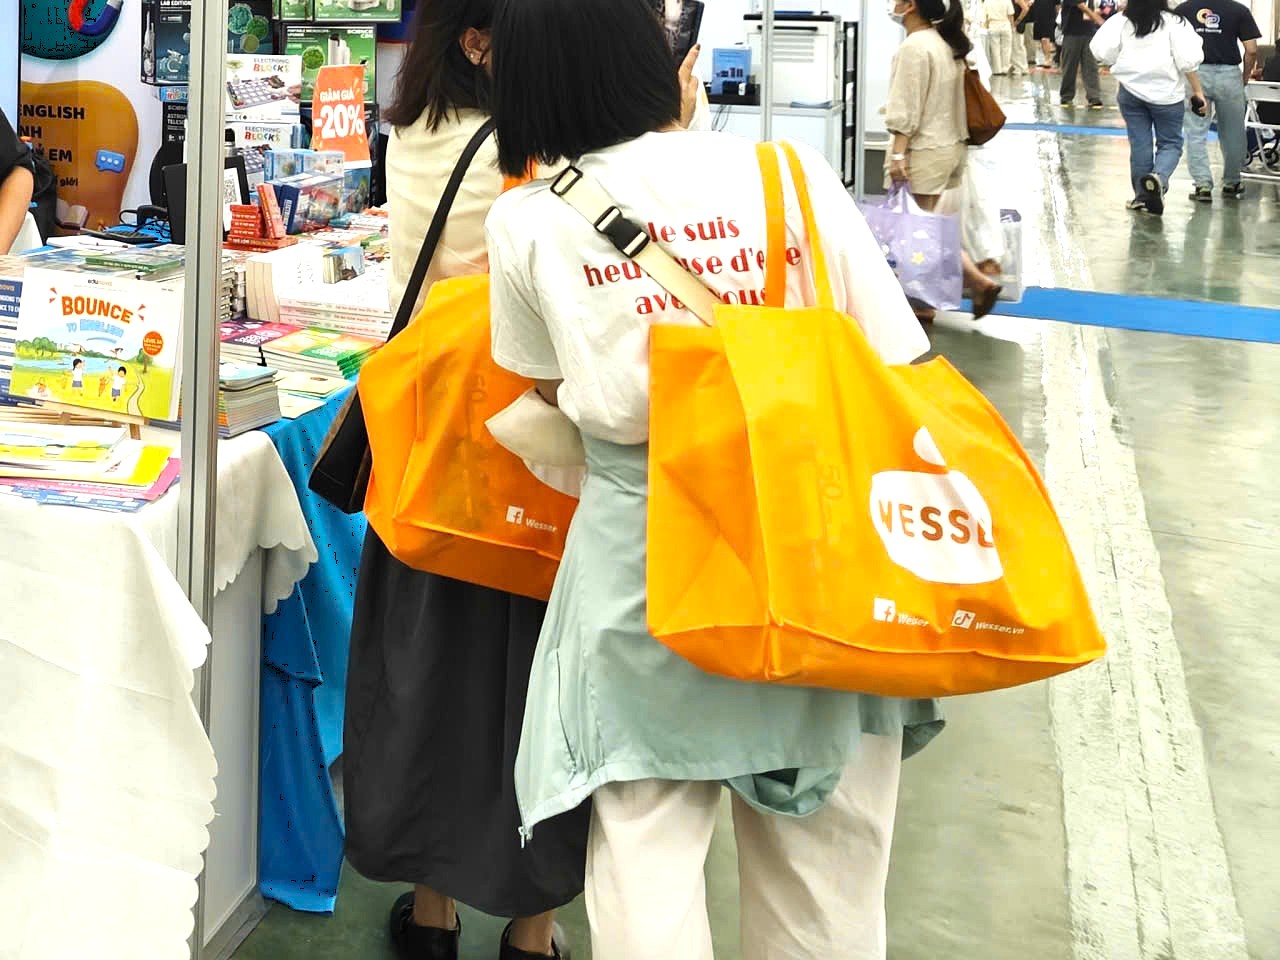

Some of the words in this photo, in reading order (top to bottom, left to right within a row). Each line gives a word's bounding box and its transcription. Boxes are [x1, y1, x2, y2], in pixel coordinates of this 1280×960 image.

[19, 104, 85, 120] NGLISH
[314, 104, 364, 139] -20%
[683, 216, 740, 242] suis
[61, 295, 134, 324] BOUNCE
